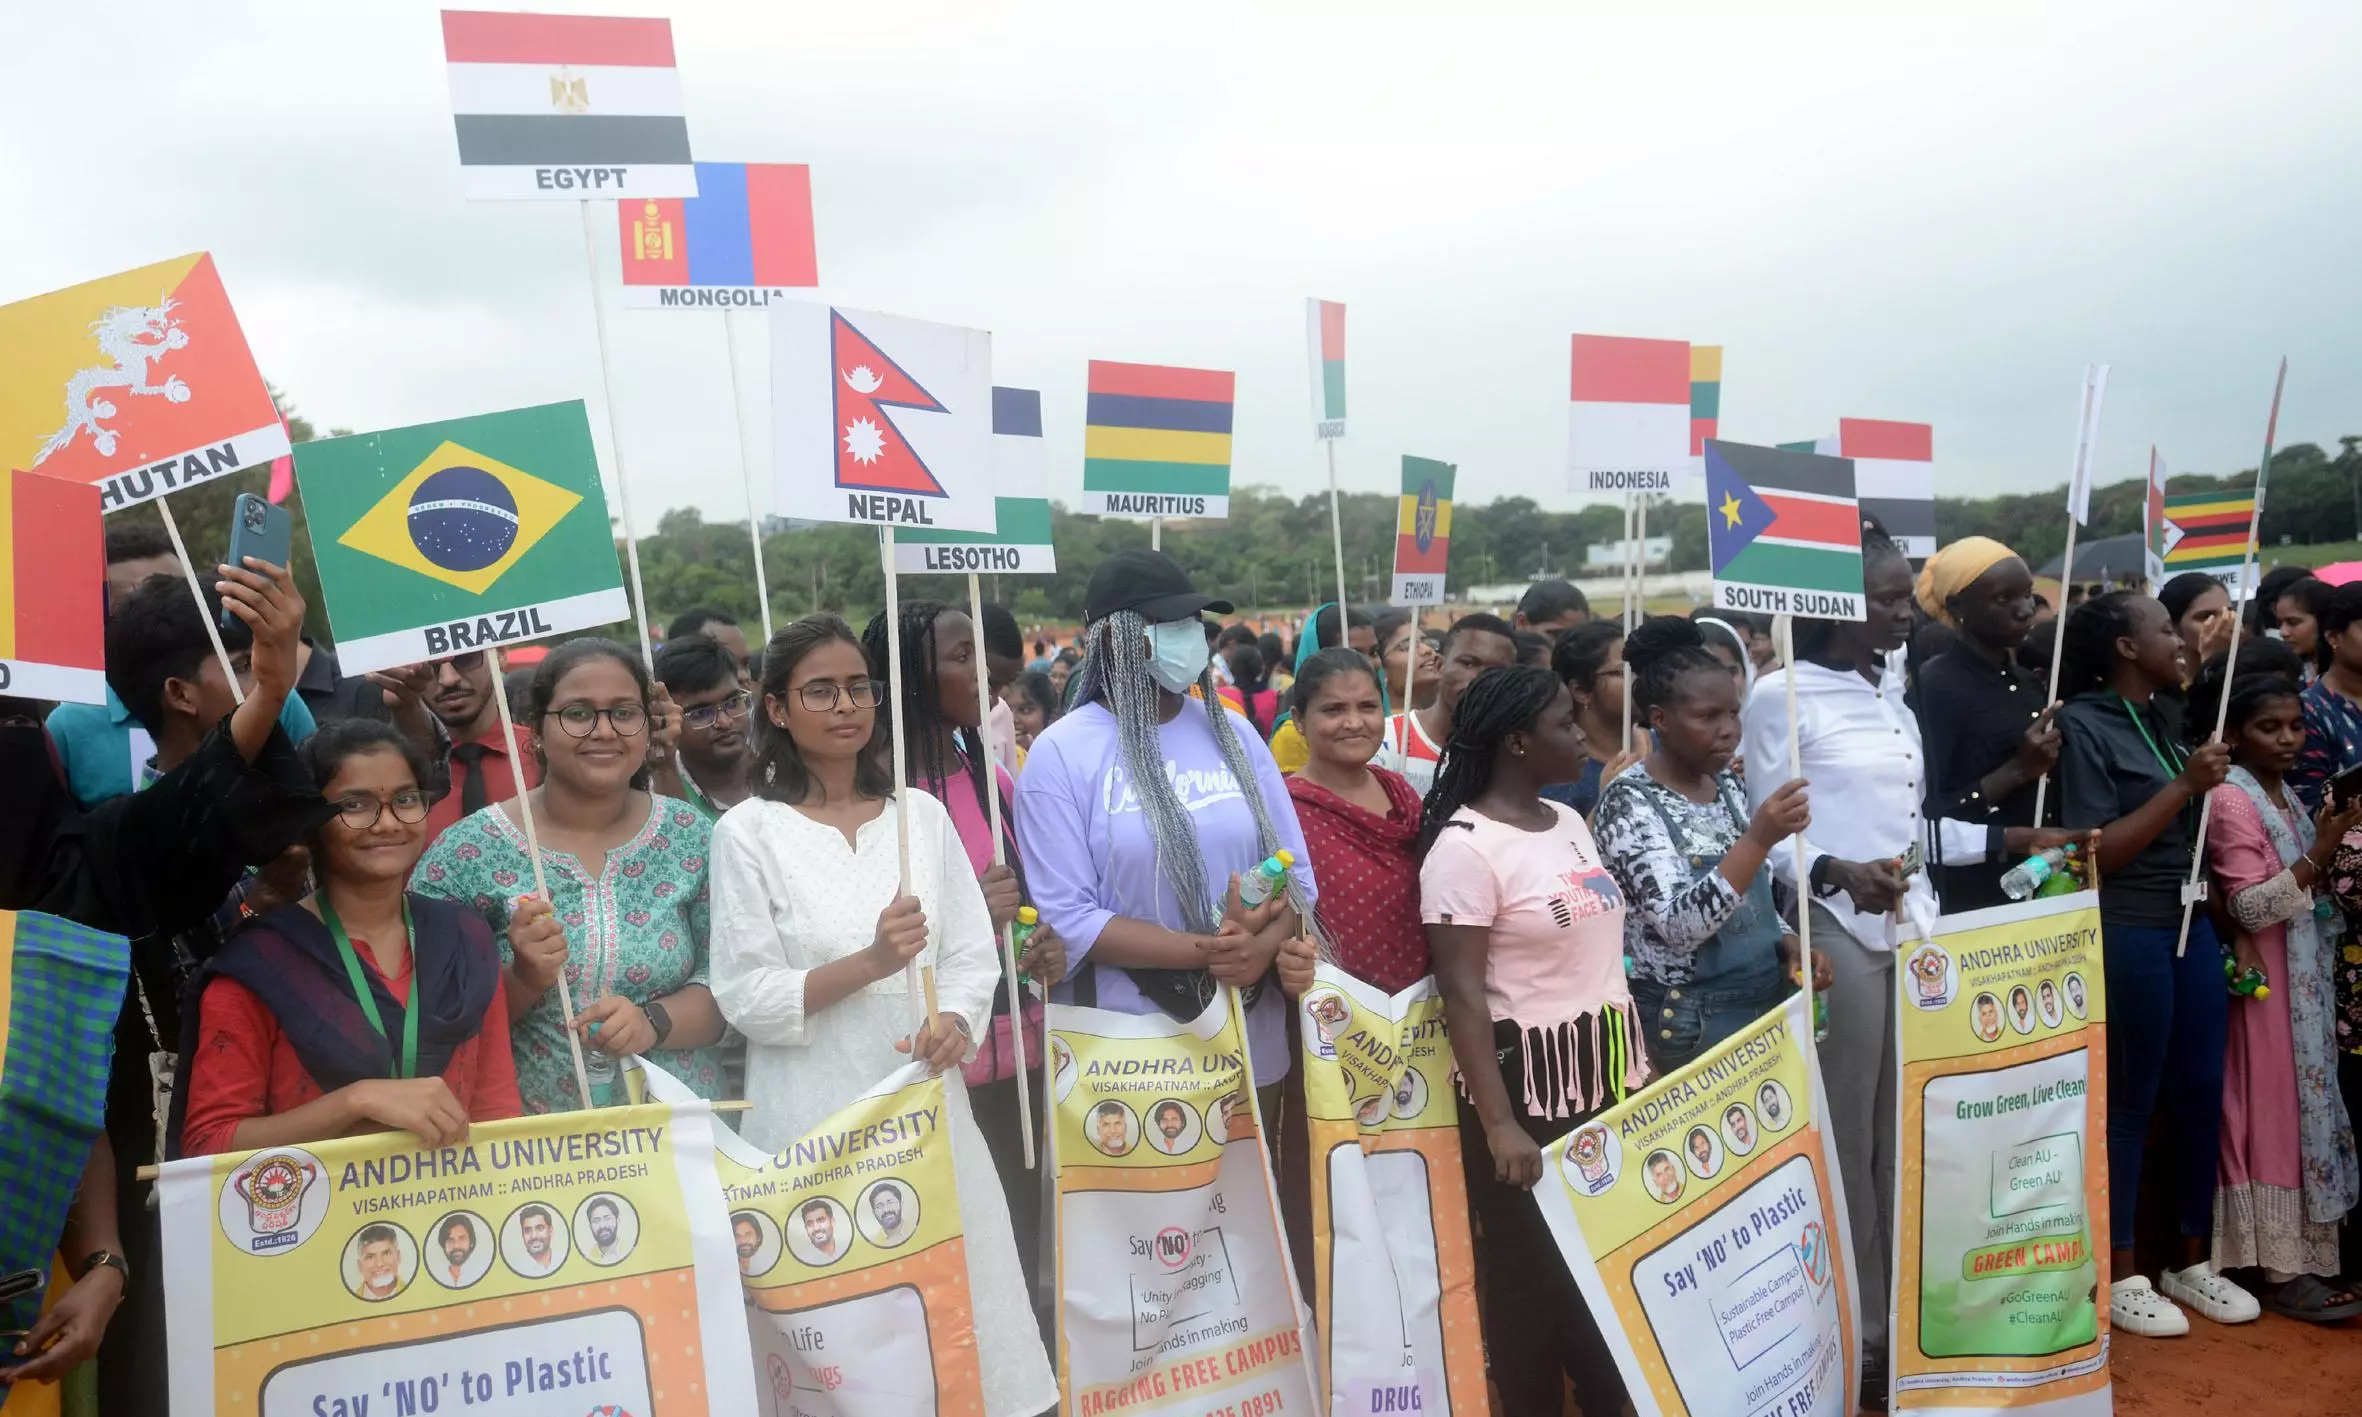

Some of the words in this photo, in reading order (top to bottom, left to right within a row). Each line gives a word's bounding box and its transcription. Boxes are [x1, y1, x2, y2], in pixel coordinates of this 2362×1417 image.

[535, 168, 628, 190] EGYPT
[101, 442, 240, 510] HUTAN
[1589, 471, 1670, 489] INDONESIA
[848, 494, 933, 525] NEPAL
[1106, 494, 1205, 515] MAURITIUS
[925, 547, 1020, 571] LESOTHO
[1725, 586, 1786, 611] SOUTH
[1793, 593, 1855, 617] SUDAN
[424, 607, 552, 656] BRAZIL
[1960, 944, 2024, 973] ANDHRA
[2024, 928, 2097, 959] UNIVERSITY
[1085, 1057, 1194, 1077] ANDHRA
[1621, 1081, 1697, 1139] ANDHRA
[1696, 1020, 1786, 1091] UNIVERSITY
[1092, 1080, 1200, 1093] VISAKHAPATNAM
[1634, 1100, 1708, 1151] VISAKHAPATNAM
[1716, 1077, 1749, 1104] ANDHRA
[1749, 1053, 1783, 1081] PRADESH
[1957, 1100, 1994, 1120] Grow
[1997, 1092, 2030, 1114] Green,
[2033, 1084, 2054, 1106] Live
[773, 1105, 939, 1170] UNIVERSITY
[339, 1145, 482, 1192] ANDHRA
[490, 1126, 664, 1170] UNIVERSITY
[792, 1166, 854, 1191] ANDHRA
[856, 1146, 924, 1175] PRADESH
[2035, 1149, 2051, 1163] AU
[352, 1183, 494, 1215] VISAKHAPATNAM
[512, 1172, 574, 1194] ANDHRA
[577, 1163, 649, 1186] PRADESH
[2010, 1176, 2043, 1191] Green
[1663, 1264, 1698, 1297] Say
[1732, 1226, 1751, 1250] to
[1750, 1187, 1807, 1237] Plastic
[1985, 1226, 2004, 1239] Join
[2006, 1221, 2040, 1235] Hands
[2042, 1218, 2051, 1228] in
[1129, 1235, 1153, 1260] Say
[1973, 1247, 2026, 1274] GREEN
[2033, 1239, 2085, 1265] CAMP
[1141, 1311, 1157, 1323] No
[1729, 1319, 1758, 1344] Plastic
[1756, 1307, 1774, 1327] Free
[792, 1326, 825, 1351] Life
[1130, 1357, 1154, 1373] Join
[1187, 1329, 1201, 1344] in
[1201, 1317, 1249, 1343] making
[312, 1393, 369, 1417] Say
[461, 1370, 493, 1406] to
[505, 1346, 612, 1397] Plastic
[1080, 1372, 1167, 1417] RAGGING
[1170, 1356, 1223, 1393] FREE
[1224, 1329, 1301, 1376] CAMPUS
[1746, 1384, 1766, 1406] Join
[1764, 1364, 1794, 1392] Hands
[1792, 1357, 1802, 1371] in
[1242, 1388, 1283, 1417] 0891
[1372, 1385, 1422, 1414] DRUG
